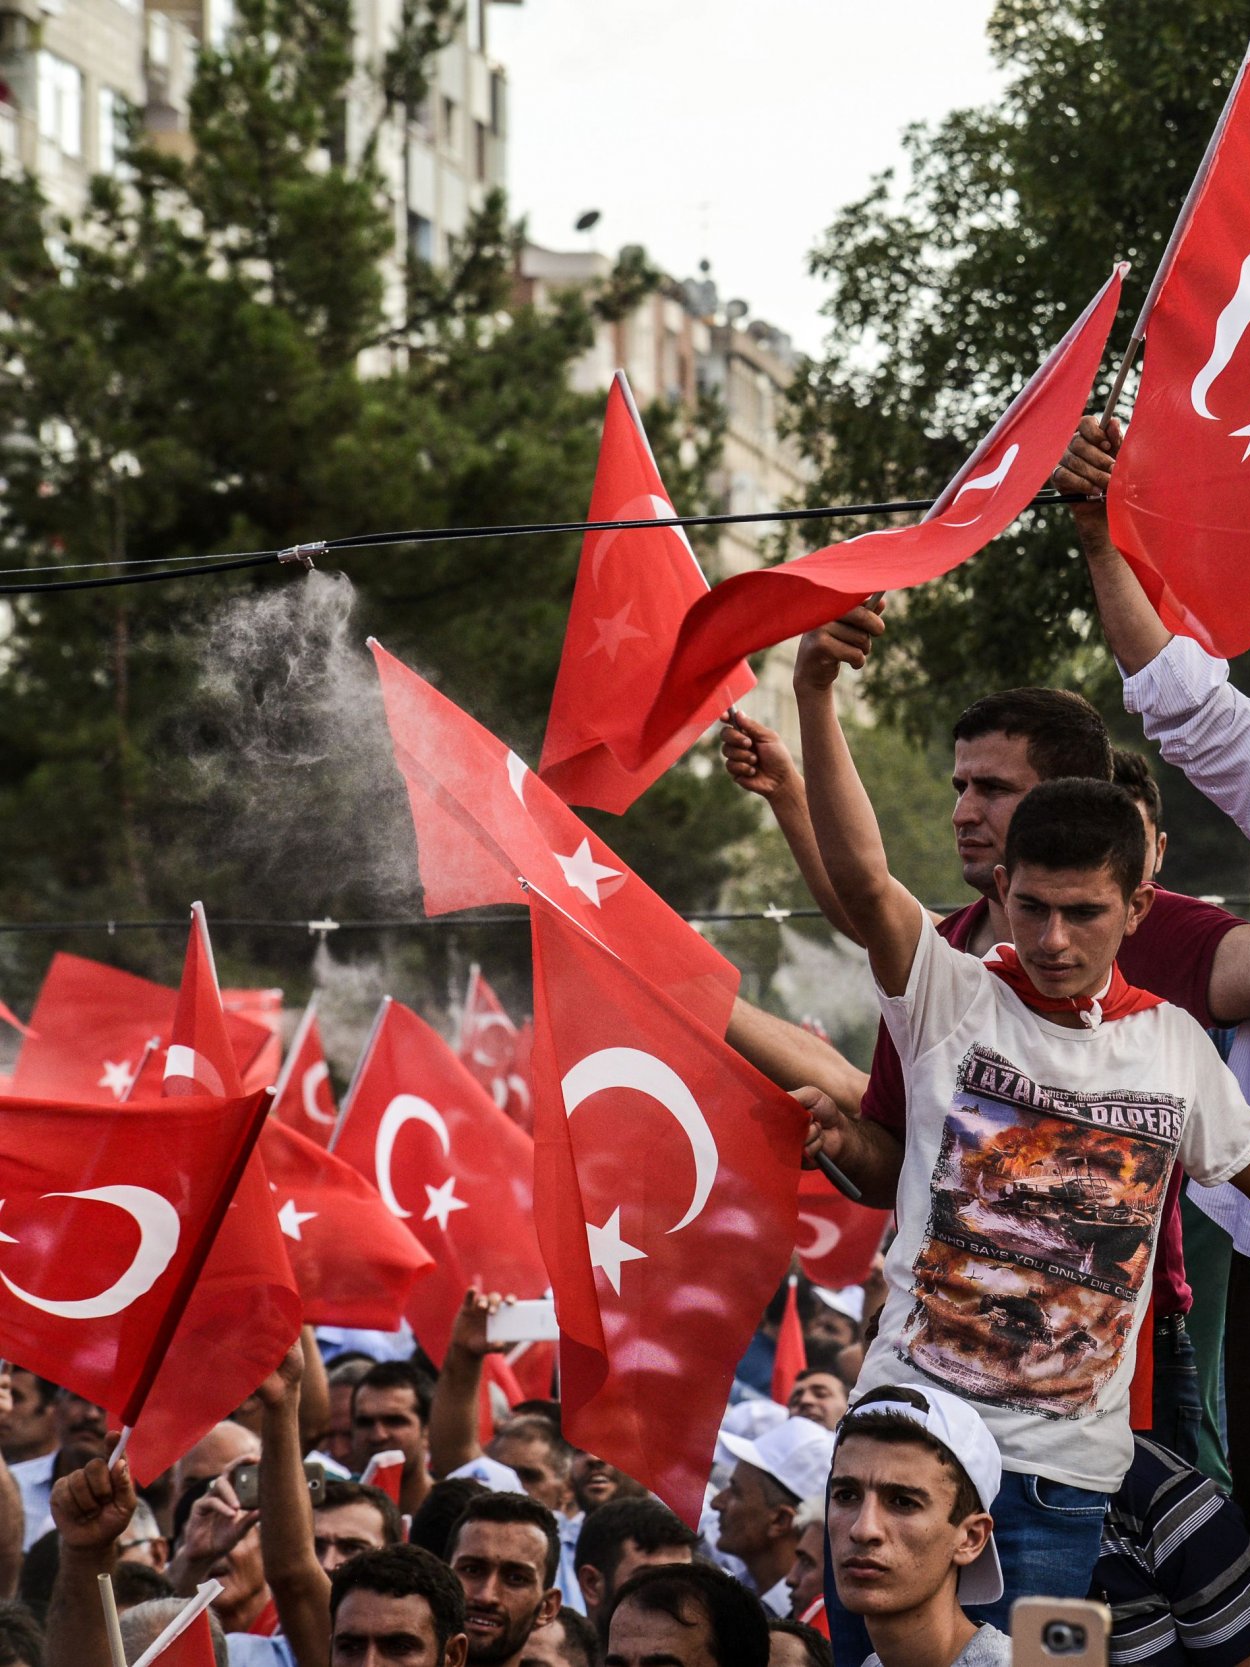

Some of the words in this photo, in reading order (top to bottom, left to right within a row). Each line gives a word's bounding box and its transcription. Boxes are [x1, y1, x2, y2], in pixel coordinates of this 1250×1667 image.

[937, 1231, 966, 1249] WHO
[969, 1243, 1010, 1260] SAYS
[1014, 1252, 1045, 1270] YOU
[1047, 1264, 1088, 1283] ONLY
[1090, 1279, 1112, 1293] DIE
